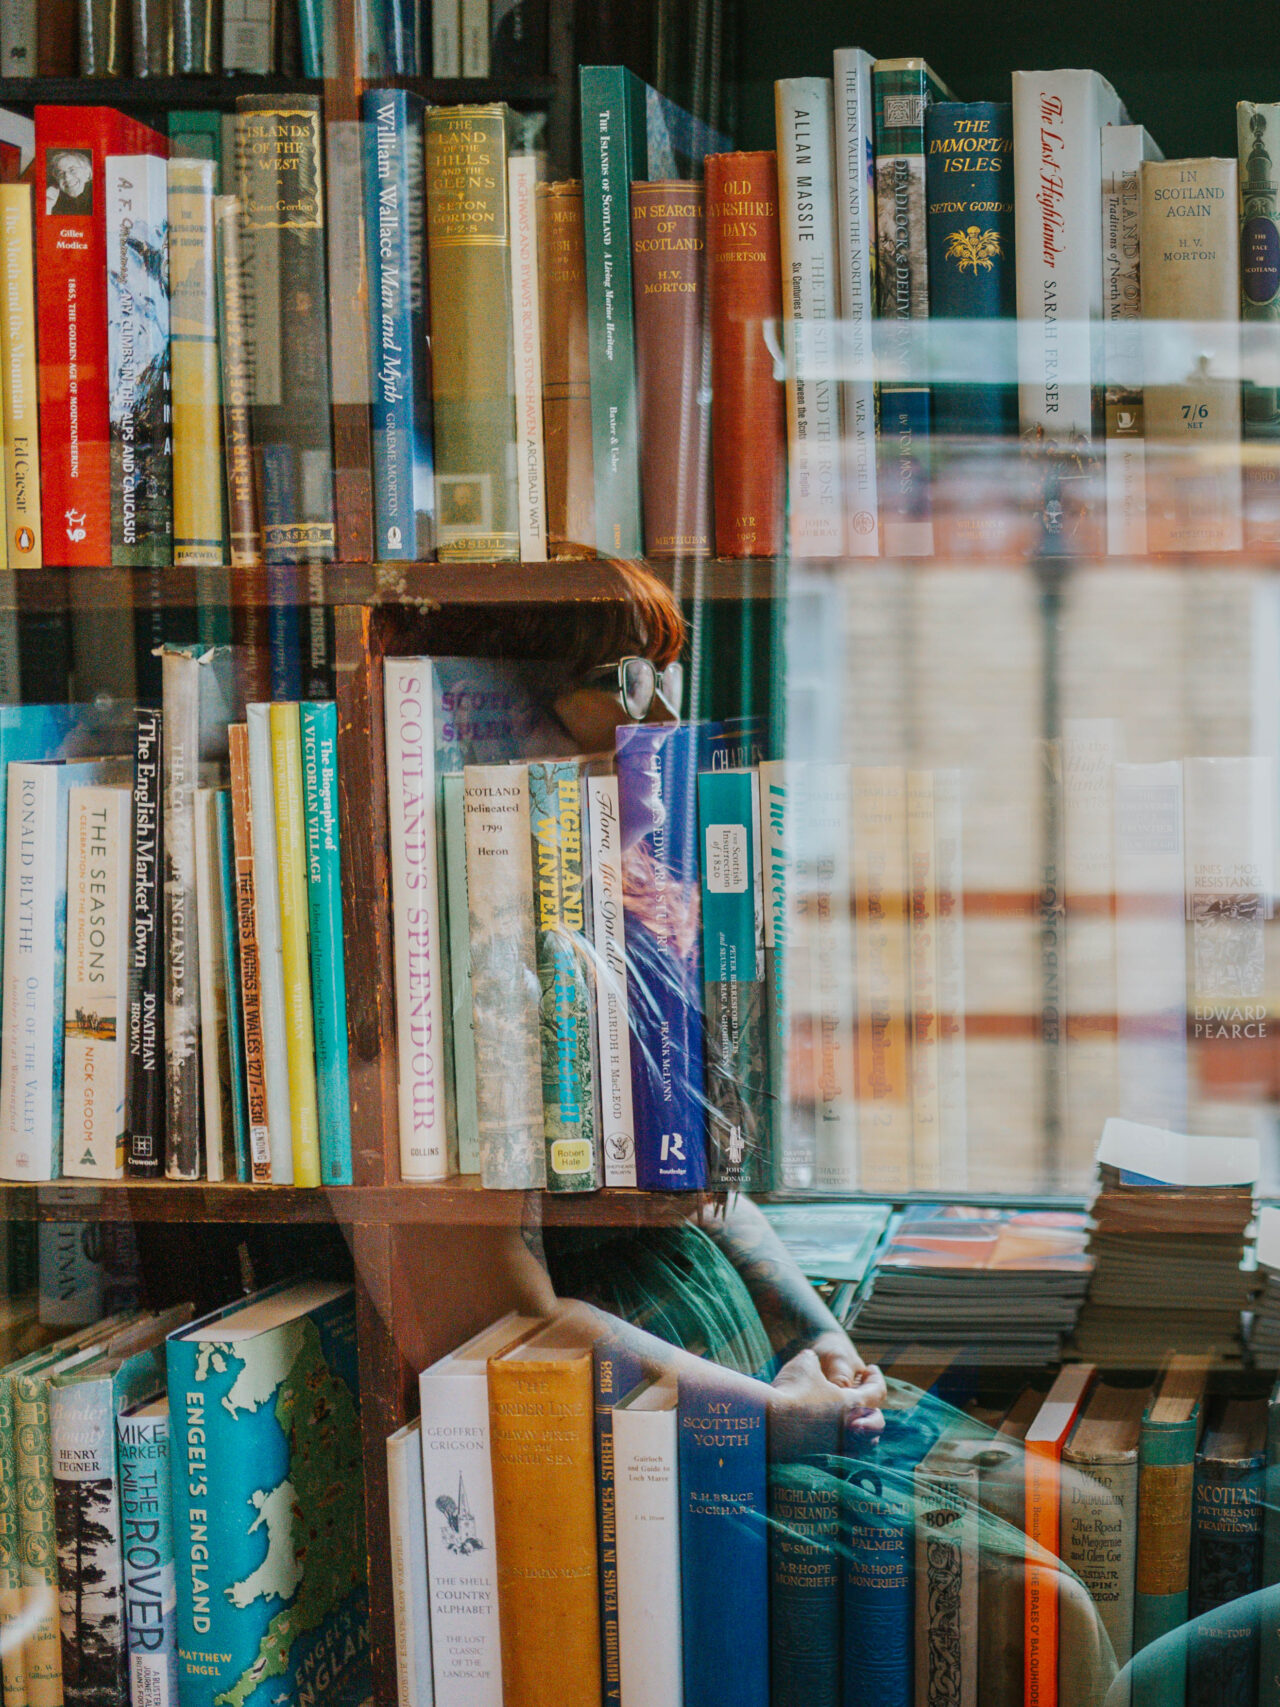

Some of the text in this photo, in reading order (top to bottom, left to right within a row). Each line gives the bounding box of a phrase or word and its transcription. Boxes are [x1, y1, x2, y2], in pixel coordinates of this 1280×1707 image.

[248, 125, 310, 140] ISLANDS
[252, 142, 304, 154] OF THE
[259, 157, 298, 170] WEST
[794, 110, 814, 241] ALLAN MASSIE
[1180, 171, 1197, 182] IN
[1154, 186, 1224, 200] SCOTLAND
[1167, 205, 1211, 217] AGAIN
[59, 230, 84, 238] Gilles
[56, 241, 88, 250] Modica
[1037, 92, 1067, 414] The Last Highlander SARAH FRASER
[68, 278, 76, 302] 1865,
[375, 103, 403, 516] William Wallace Man and Myth GRAEME MORTON
[69, 323, 77, 361] GOLDEN
[70, 382, 77, 394] OF
[70, 396, 79, 478] MOUNTAINEERING
[304, 712, 321, 884] A VICTORIAN VILLAGE
[319, 739, 337, 851] The Biography of
[464, 786, 520, 797] SCOTLAND
[466, 804, 519, 814] Delineated
[481, 823, 502, 834] 1799
[135, 718, 156, 969] The English Market Town
[477, 847, 508, 856] Heron
[557, 780, 582, 930] HIGHLAND
[536, 815, 559, 933] WINTER
[90, 809, 107, 984] THE SEASONS
[398, 676, 435, 1131] SCOTLAND'S SPLENDOUR
[1194, 1006, 1266, 1021] EDWARD
[130, 1002, 140, 1054] BROWN
[143, 992, 155, 1070] JONATHAN
[1194, 1024, 1266, 1039] PEARCE
[83, 1047, 93, 1141] NICK GROOM
[410, 1147, 439, 1156] COLLINS
[128, 1157, 158, 1167] Crowood
[708, 1403, 731, 1414] MY
[683, 1417, 760, 1430] SCOTTISH
[117, 1424, 166, 1444] MIKE
[427, 1427, 485, 1438] GEOFFREY
[430, 1441, 484, 1451] GRIGSON
[694, 1434, 750, 1447] YOUTH
[60, 1449, 97, 1460] HENRY
[58, 1461, 100, 1472] TEGNER
[121, 1463, 138, 1514] WILD
[138, 1469, 159, 1513] THE
[185, 1392, 211, 1634] ENGEL'S ENGLAND
[125, 1520, 164, 1651] ROVER
[436, 1577, 491, 1586] THE SHELL
[436, 1591, 491, 1600] COUNTRY
[436, 1605, 492, 1615] ALPHABET
[179, 1650, 232, 1663] MATTHEW
[187, 1664, 221, 1676] ENGEL
